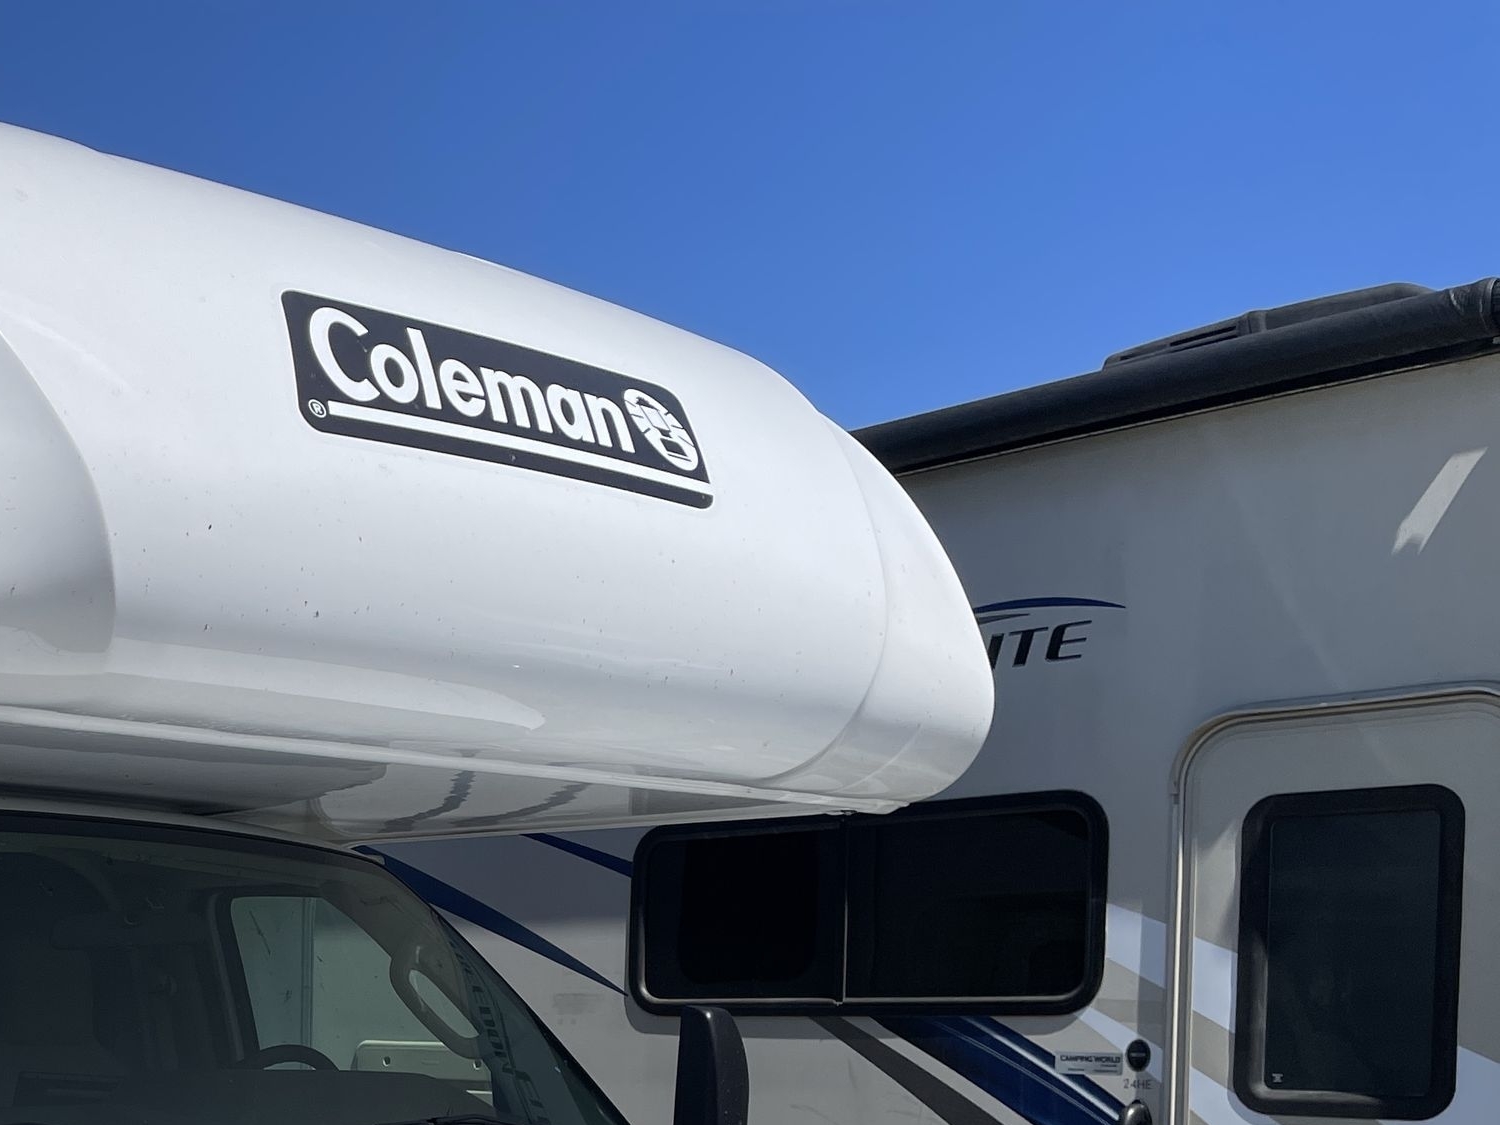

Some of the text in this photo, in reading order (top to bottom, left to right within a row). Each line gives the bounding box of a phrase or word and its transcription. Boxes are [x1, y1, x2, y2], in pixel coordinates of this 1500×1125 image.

[309, 306, 636, 454] Coleman
[1060, 1055, 1121, 1064] CAMPING WORLD
